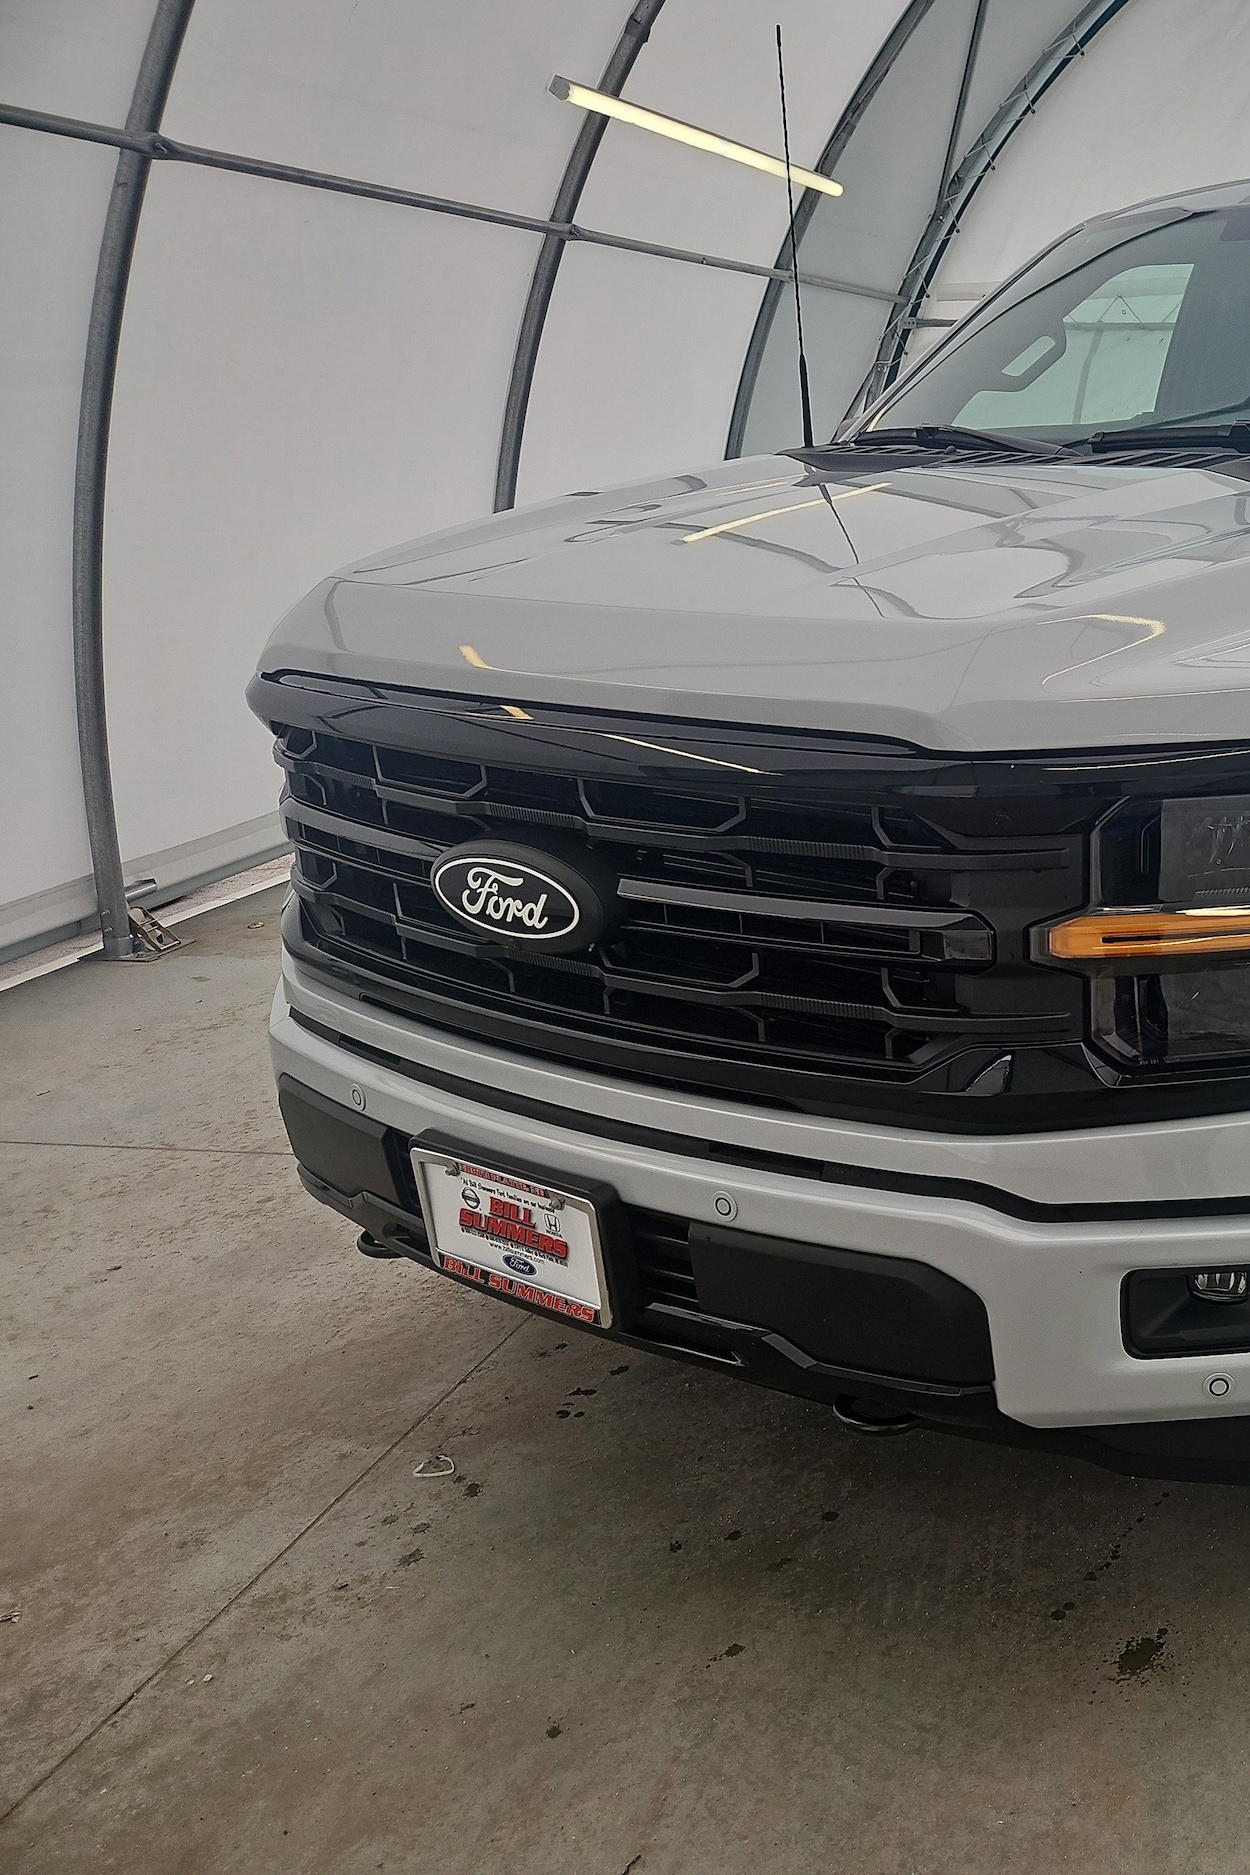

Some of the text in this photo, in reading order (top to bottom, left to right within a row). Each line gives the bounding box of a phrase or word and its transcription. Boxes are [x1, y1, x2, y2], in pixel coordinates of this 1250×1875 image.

[462, 867, 548, 930] Ford
[459, 1208, 568, 1258] SUMMERS
[489, 1197, 535, 1227] BILL
[443, 1256, 595, 1323] BILL SUMMERS
[509, 1257, 530, 1272] Ford
